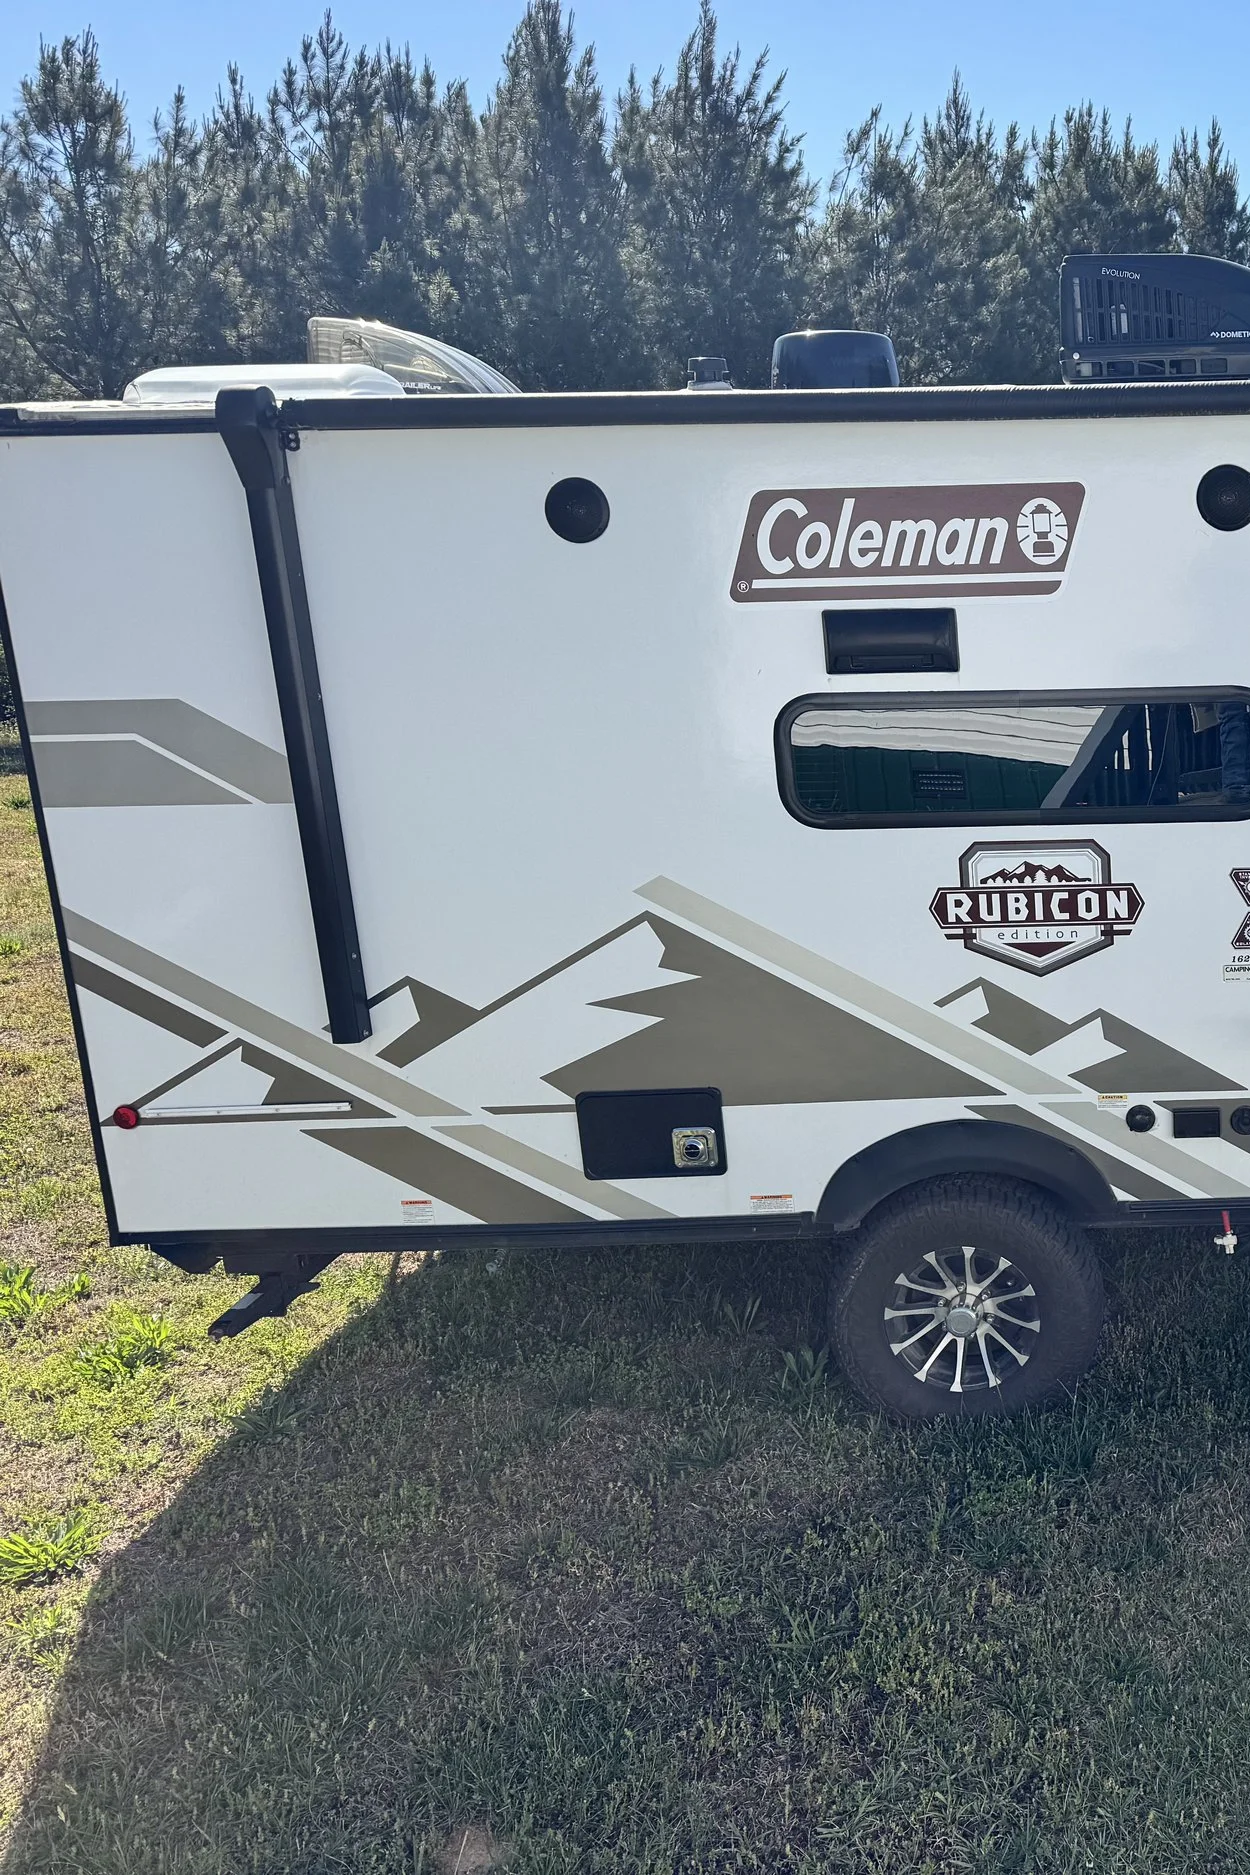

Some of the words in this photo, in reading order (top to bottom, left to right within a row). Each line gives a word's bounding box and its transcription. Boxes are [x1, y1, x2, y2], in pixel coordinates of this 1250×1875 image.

[1101, 267, 1141, 280] EVOLUTION
[400, 381, 431, 390] RAILER
[757, 497, 1009, 575] Coleman
[946, 890, 1129, 923] RUBICON
[997, 928, 1079, 940] edition
